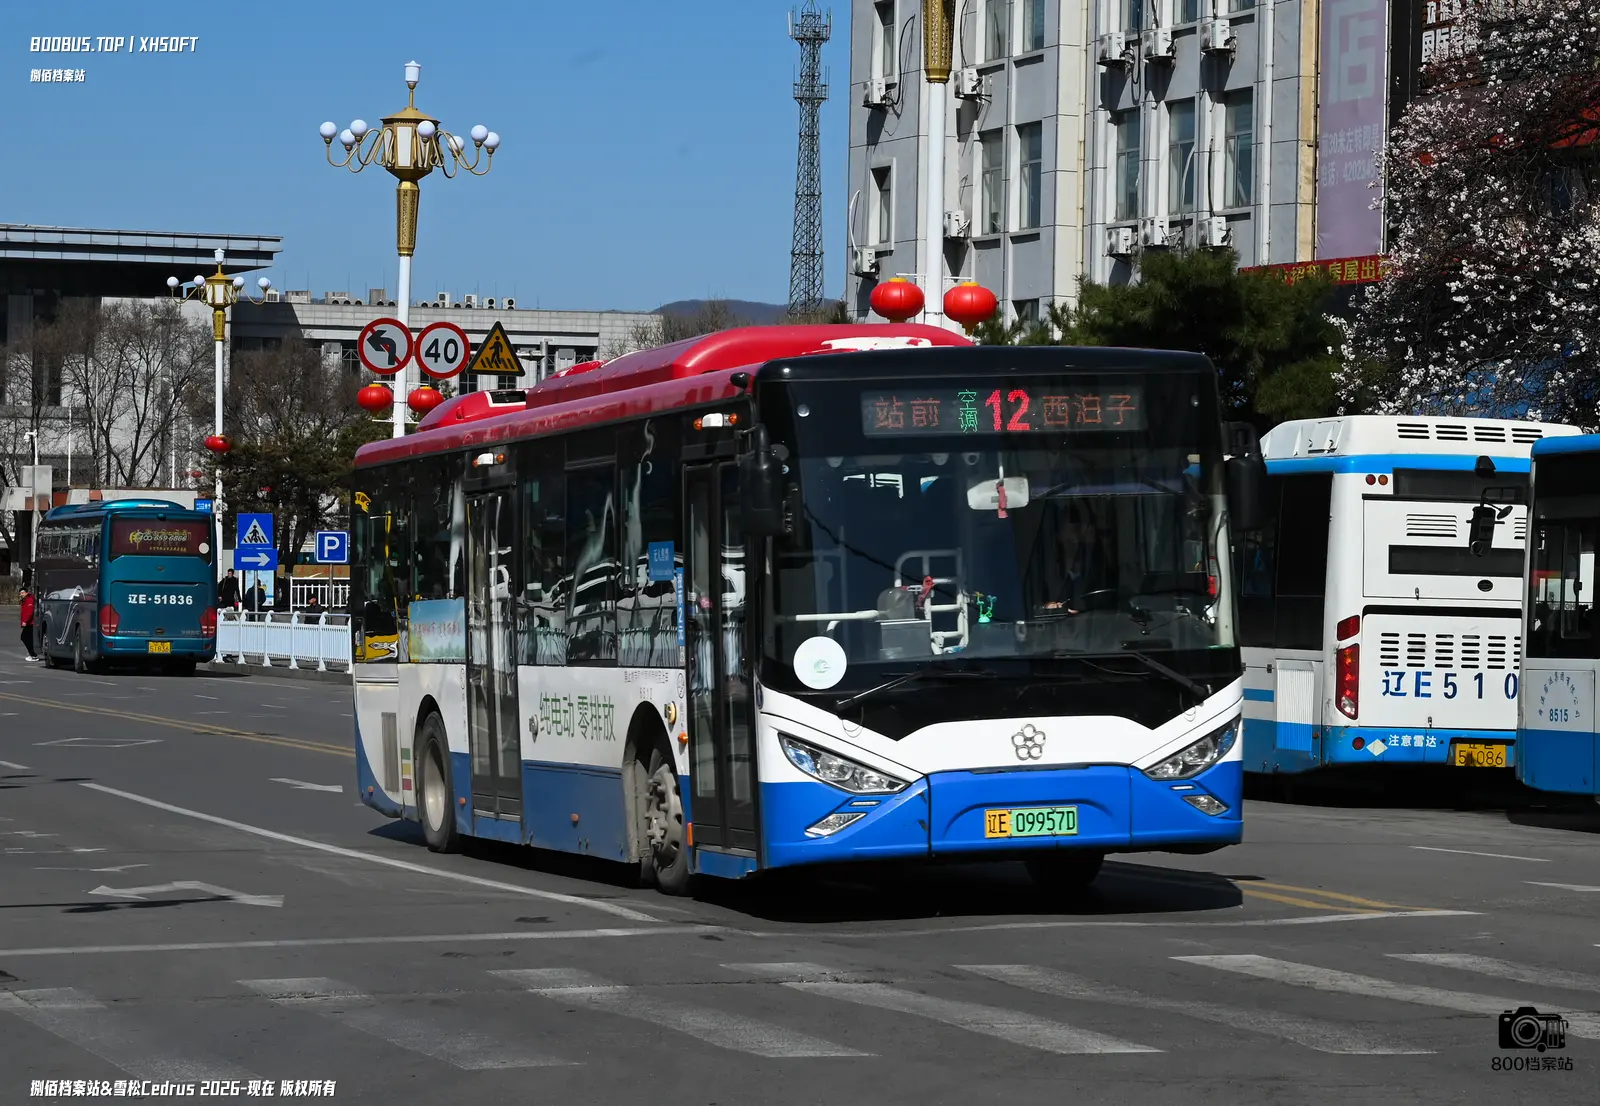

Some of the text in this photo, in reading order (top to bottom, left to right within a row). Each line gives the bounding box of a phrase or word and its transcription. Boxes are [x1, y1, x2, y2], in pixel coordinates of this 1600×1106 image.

[425, 338, 459, 364] 40
[875, 396, 941, 428] 站前
[957, 389, 978, 432] 空调
[985, 389, 1031, 431] 12
[324, 536, 340, 558] P
[1549, 708, 1569, 723] 8515
[1388, 734, 1437, 748] 注意雷达
[1458, 750, 1504, 765] 51086
